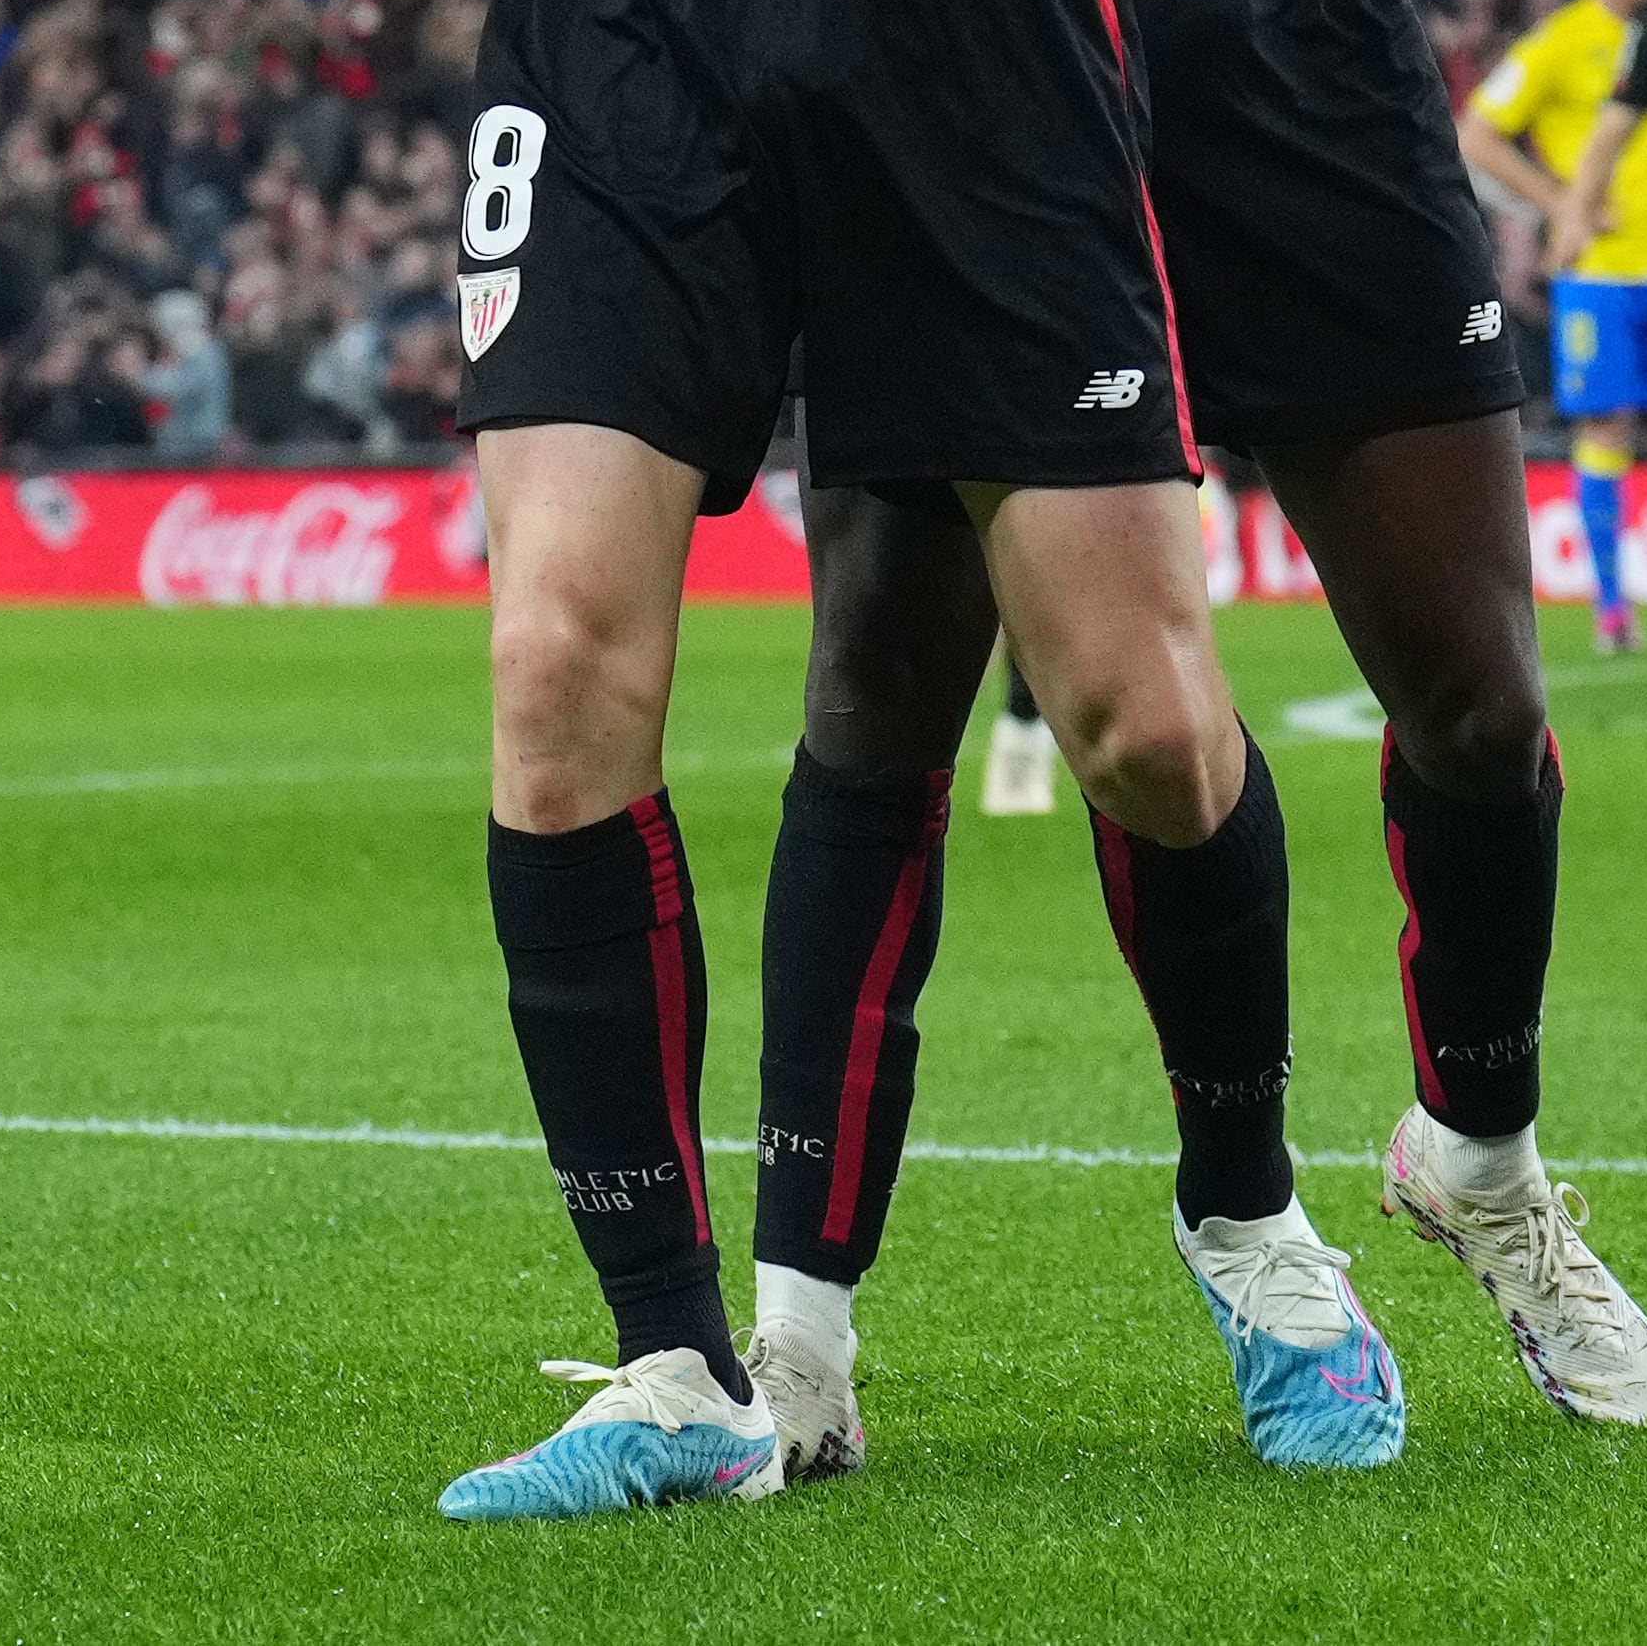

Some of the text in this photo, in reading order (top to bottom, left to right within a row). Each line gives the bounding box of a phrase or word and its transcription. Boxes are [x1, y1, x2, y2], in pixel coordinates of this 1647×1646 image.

[461, 104, 547, 261] 8
[554, 1162, 678, 1191] HLETIC
[562, 1190, 635, 1213] CLUB
